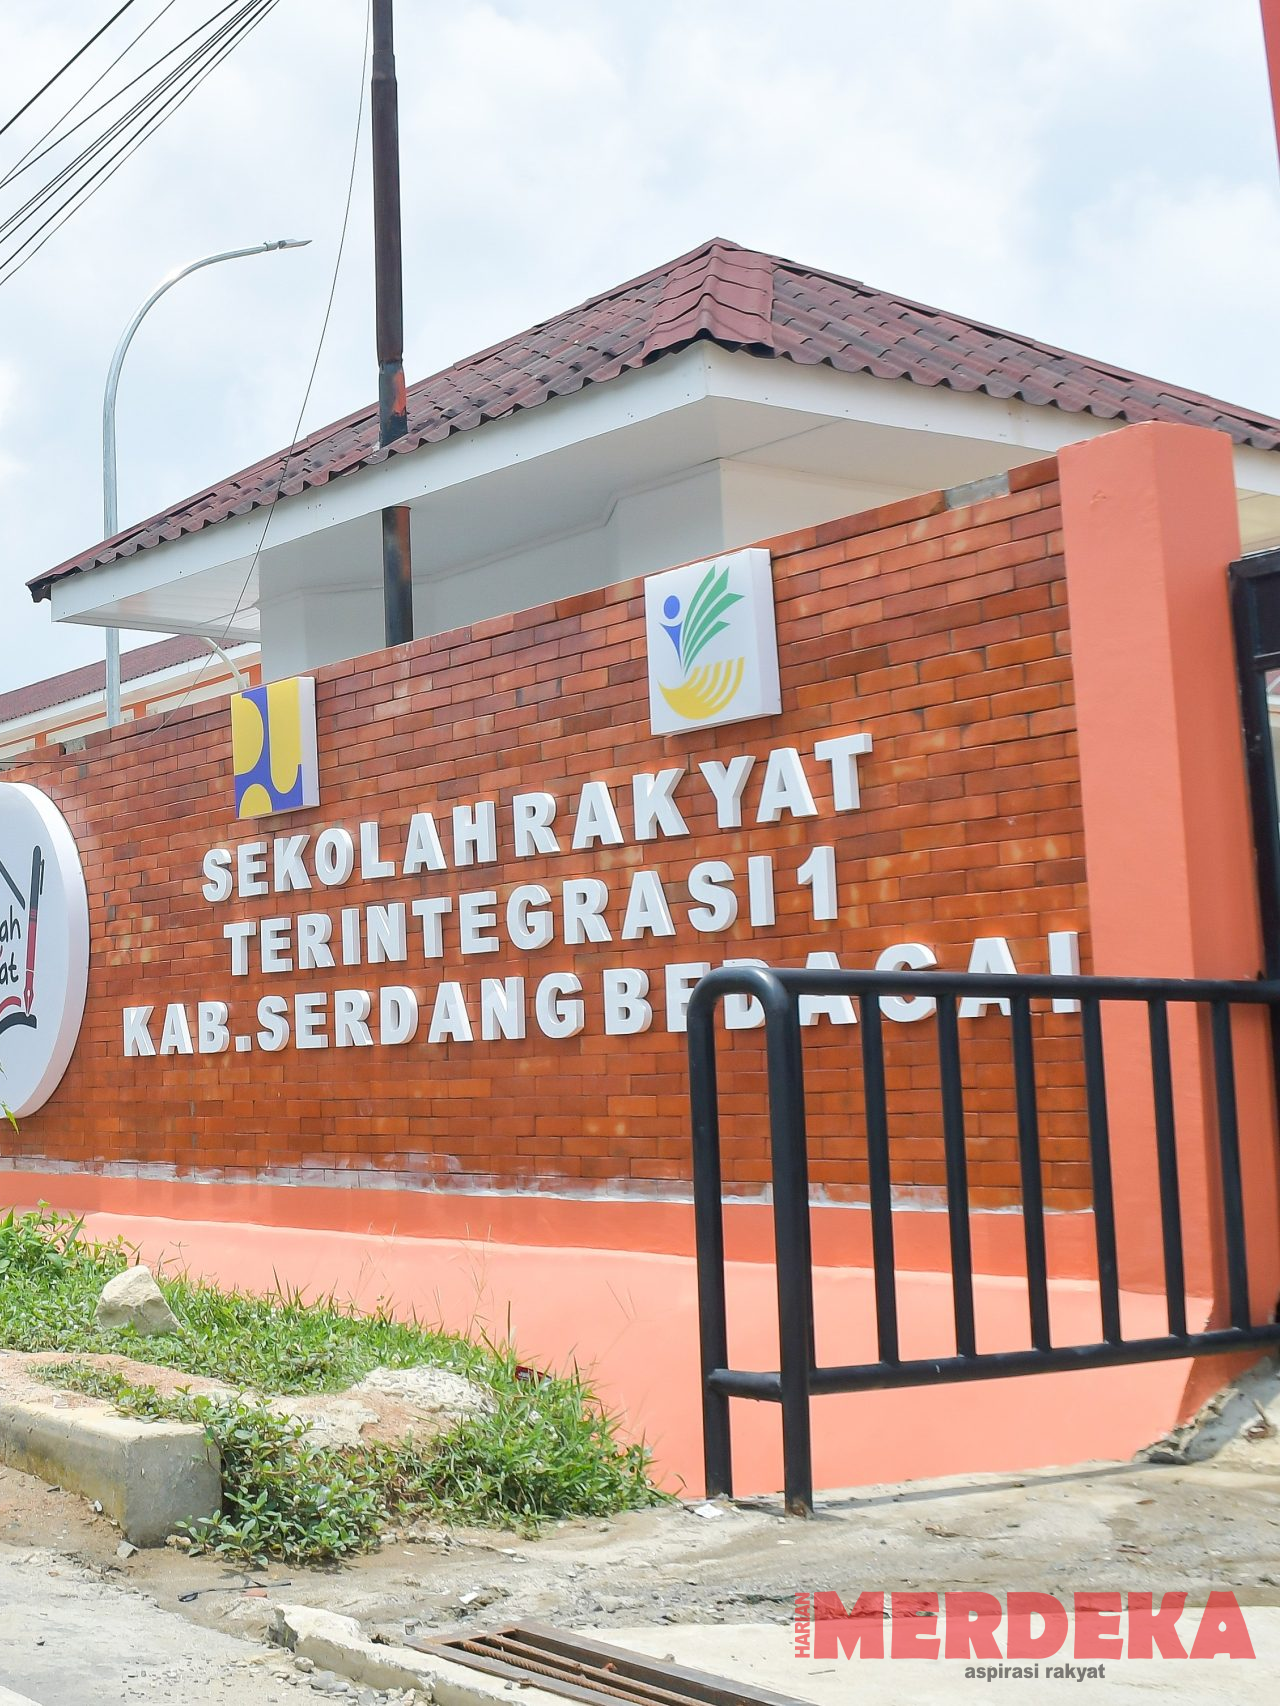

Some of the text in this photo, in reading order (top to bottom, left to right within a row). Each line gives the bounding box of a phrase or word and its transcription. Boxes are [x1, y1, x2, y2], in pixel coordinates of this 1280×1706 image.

[202, 733, 873, 902] SEKOLAH RAKYAT
[224, 845, 838, 976] TERINTEGRASI 1
